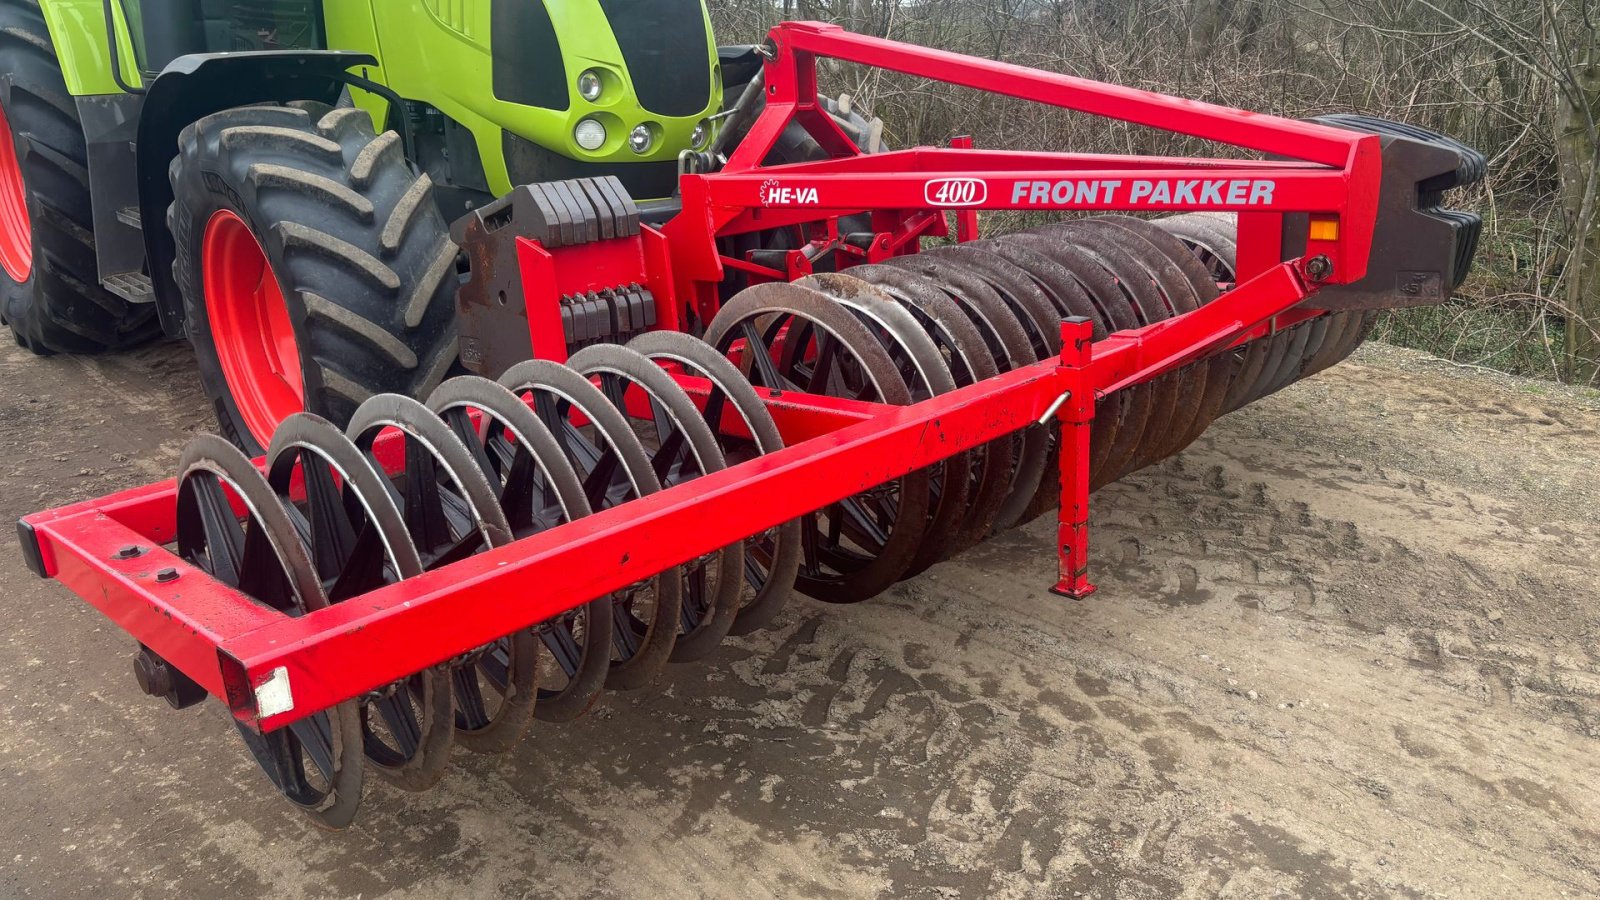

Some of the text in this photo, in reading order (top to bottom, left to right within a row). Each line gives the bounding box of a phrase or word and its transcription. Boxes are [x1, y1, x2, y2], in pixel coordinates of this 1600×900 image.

[768, 188, 818, 203] HE-VA
[935, 181, 976, 203] 400
[1011, 180, 1275, 204] FRONT PAKKER
